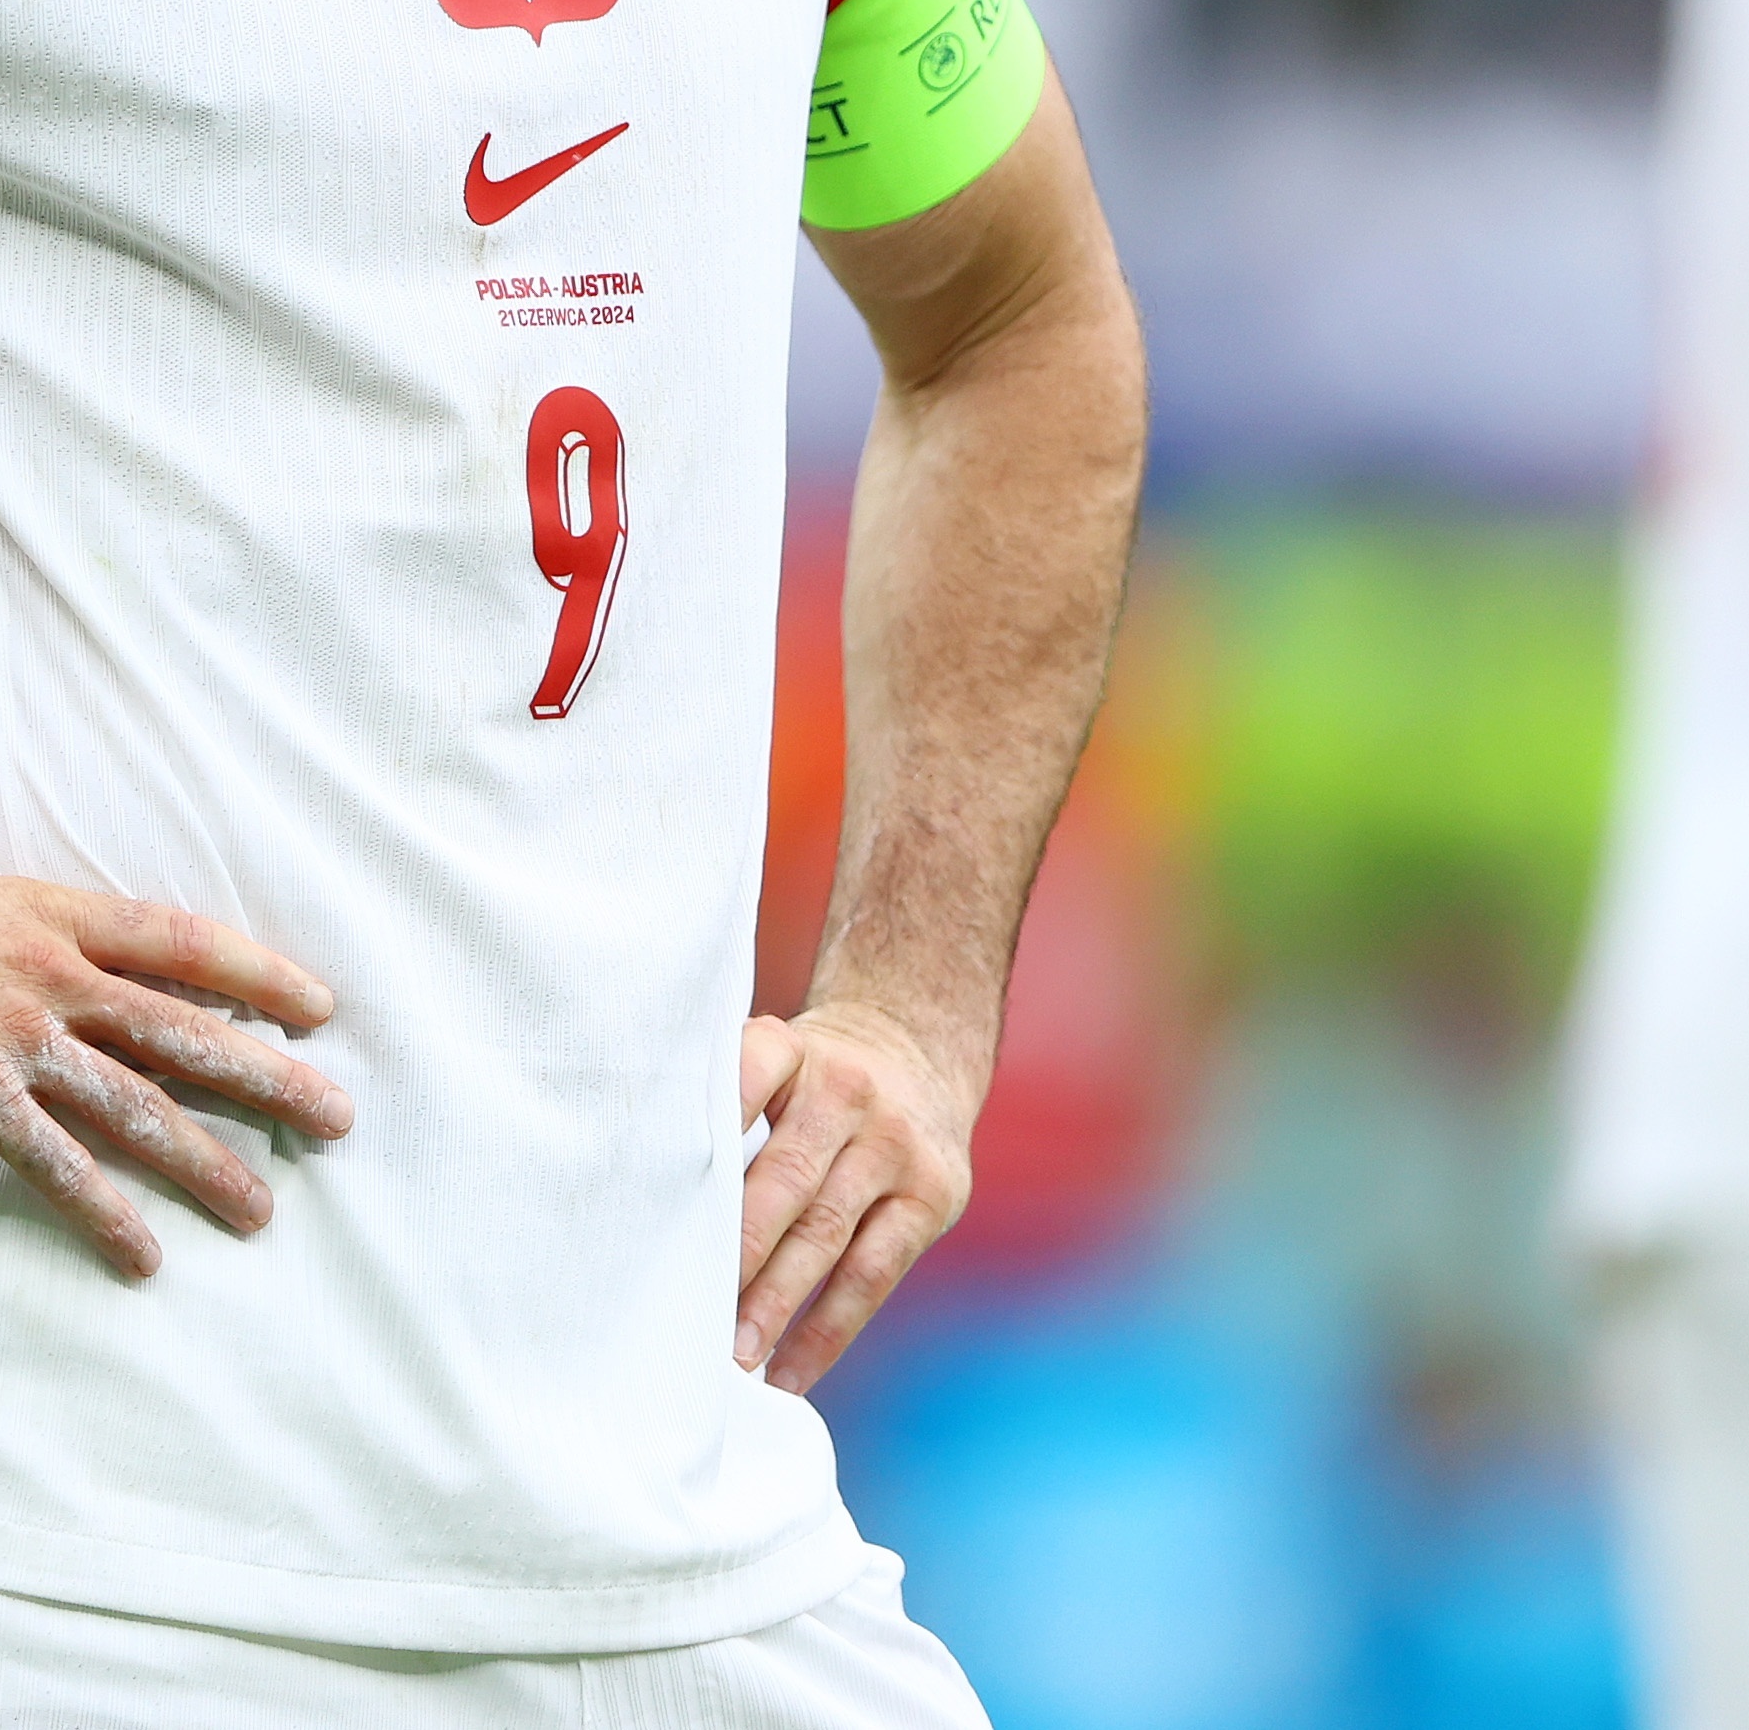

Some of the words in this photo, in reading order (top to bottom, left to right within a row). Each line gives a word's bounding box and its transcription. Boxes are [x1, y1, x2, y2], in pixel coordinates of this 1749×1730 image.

[497, 309, 516, 327] 21
[517, 308, 588, 326] CZERWCA
[590, 305, 635, 325] 2024
[526, 385, 629, 720] 9
